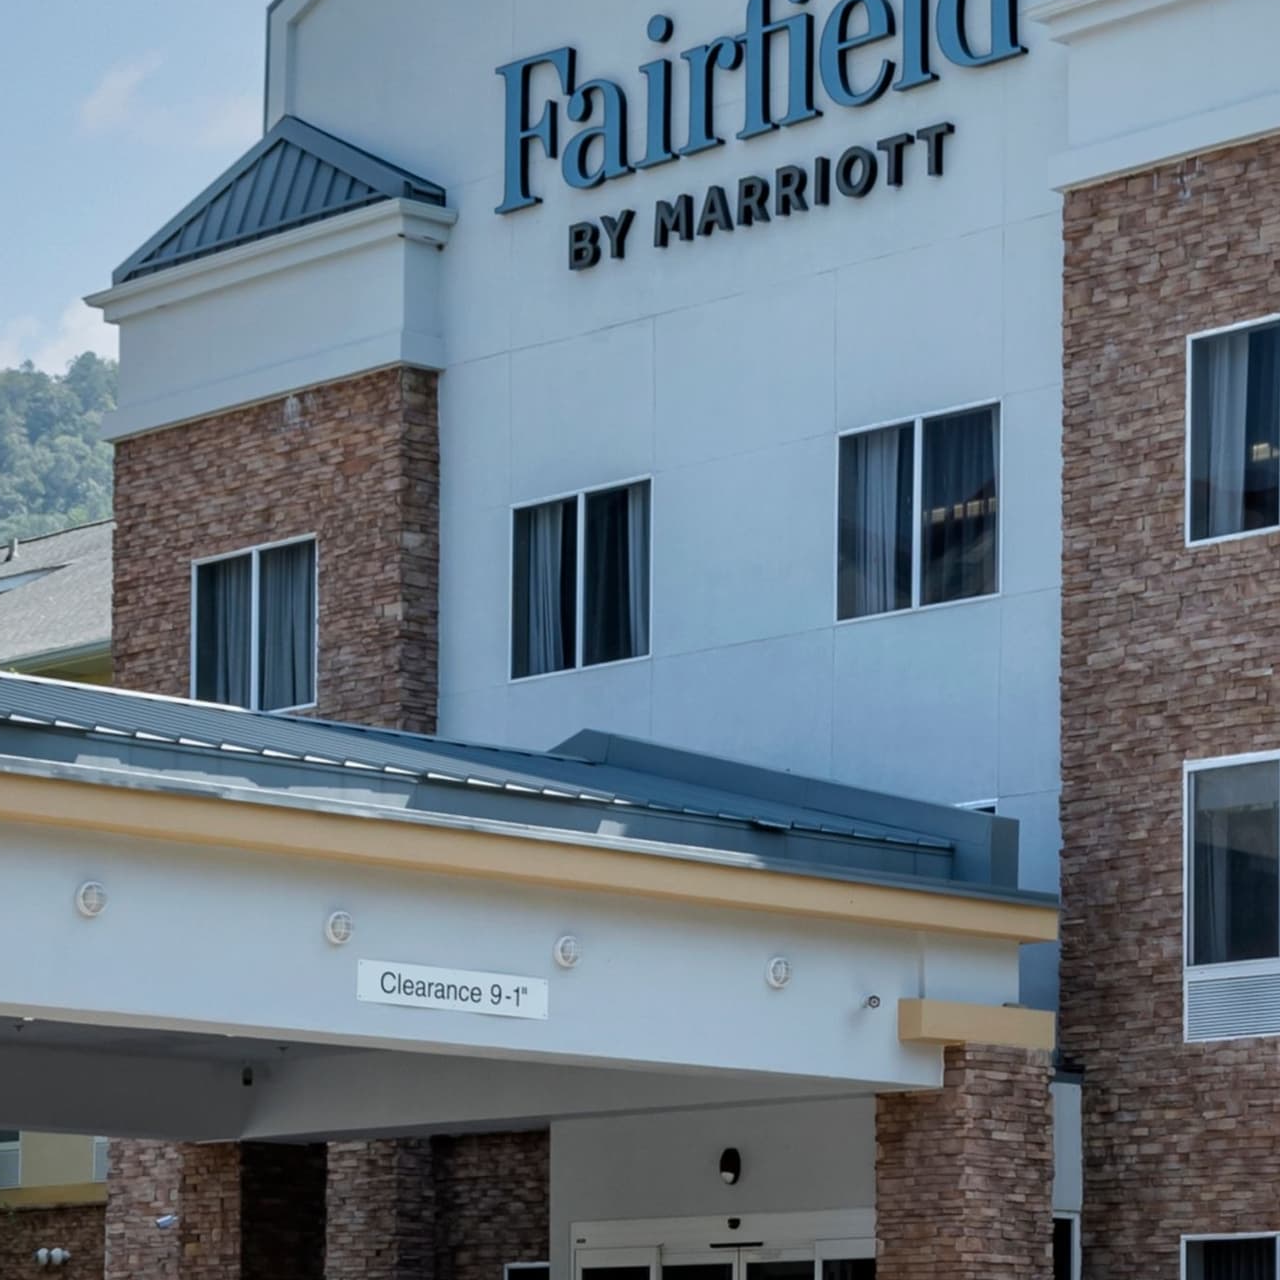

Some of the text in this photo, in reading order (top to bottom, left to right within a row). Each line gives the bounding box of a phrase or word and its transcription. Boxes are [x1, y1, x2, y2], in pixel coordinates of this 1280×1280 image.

[568, 122, 955, 270] BY MARRIOTT
[380, 971, 482, 1003] Clearance
